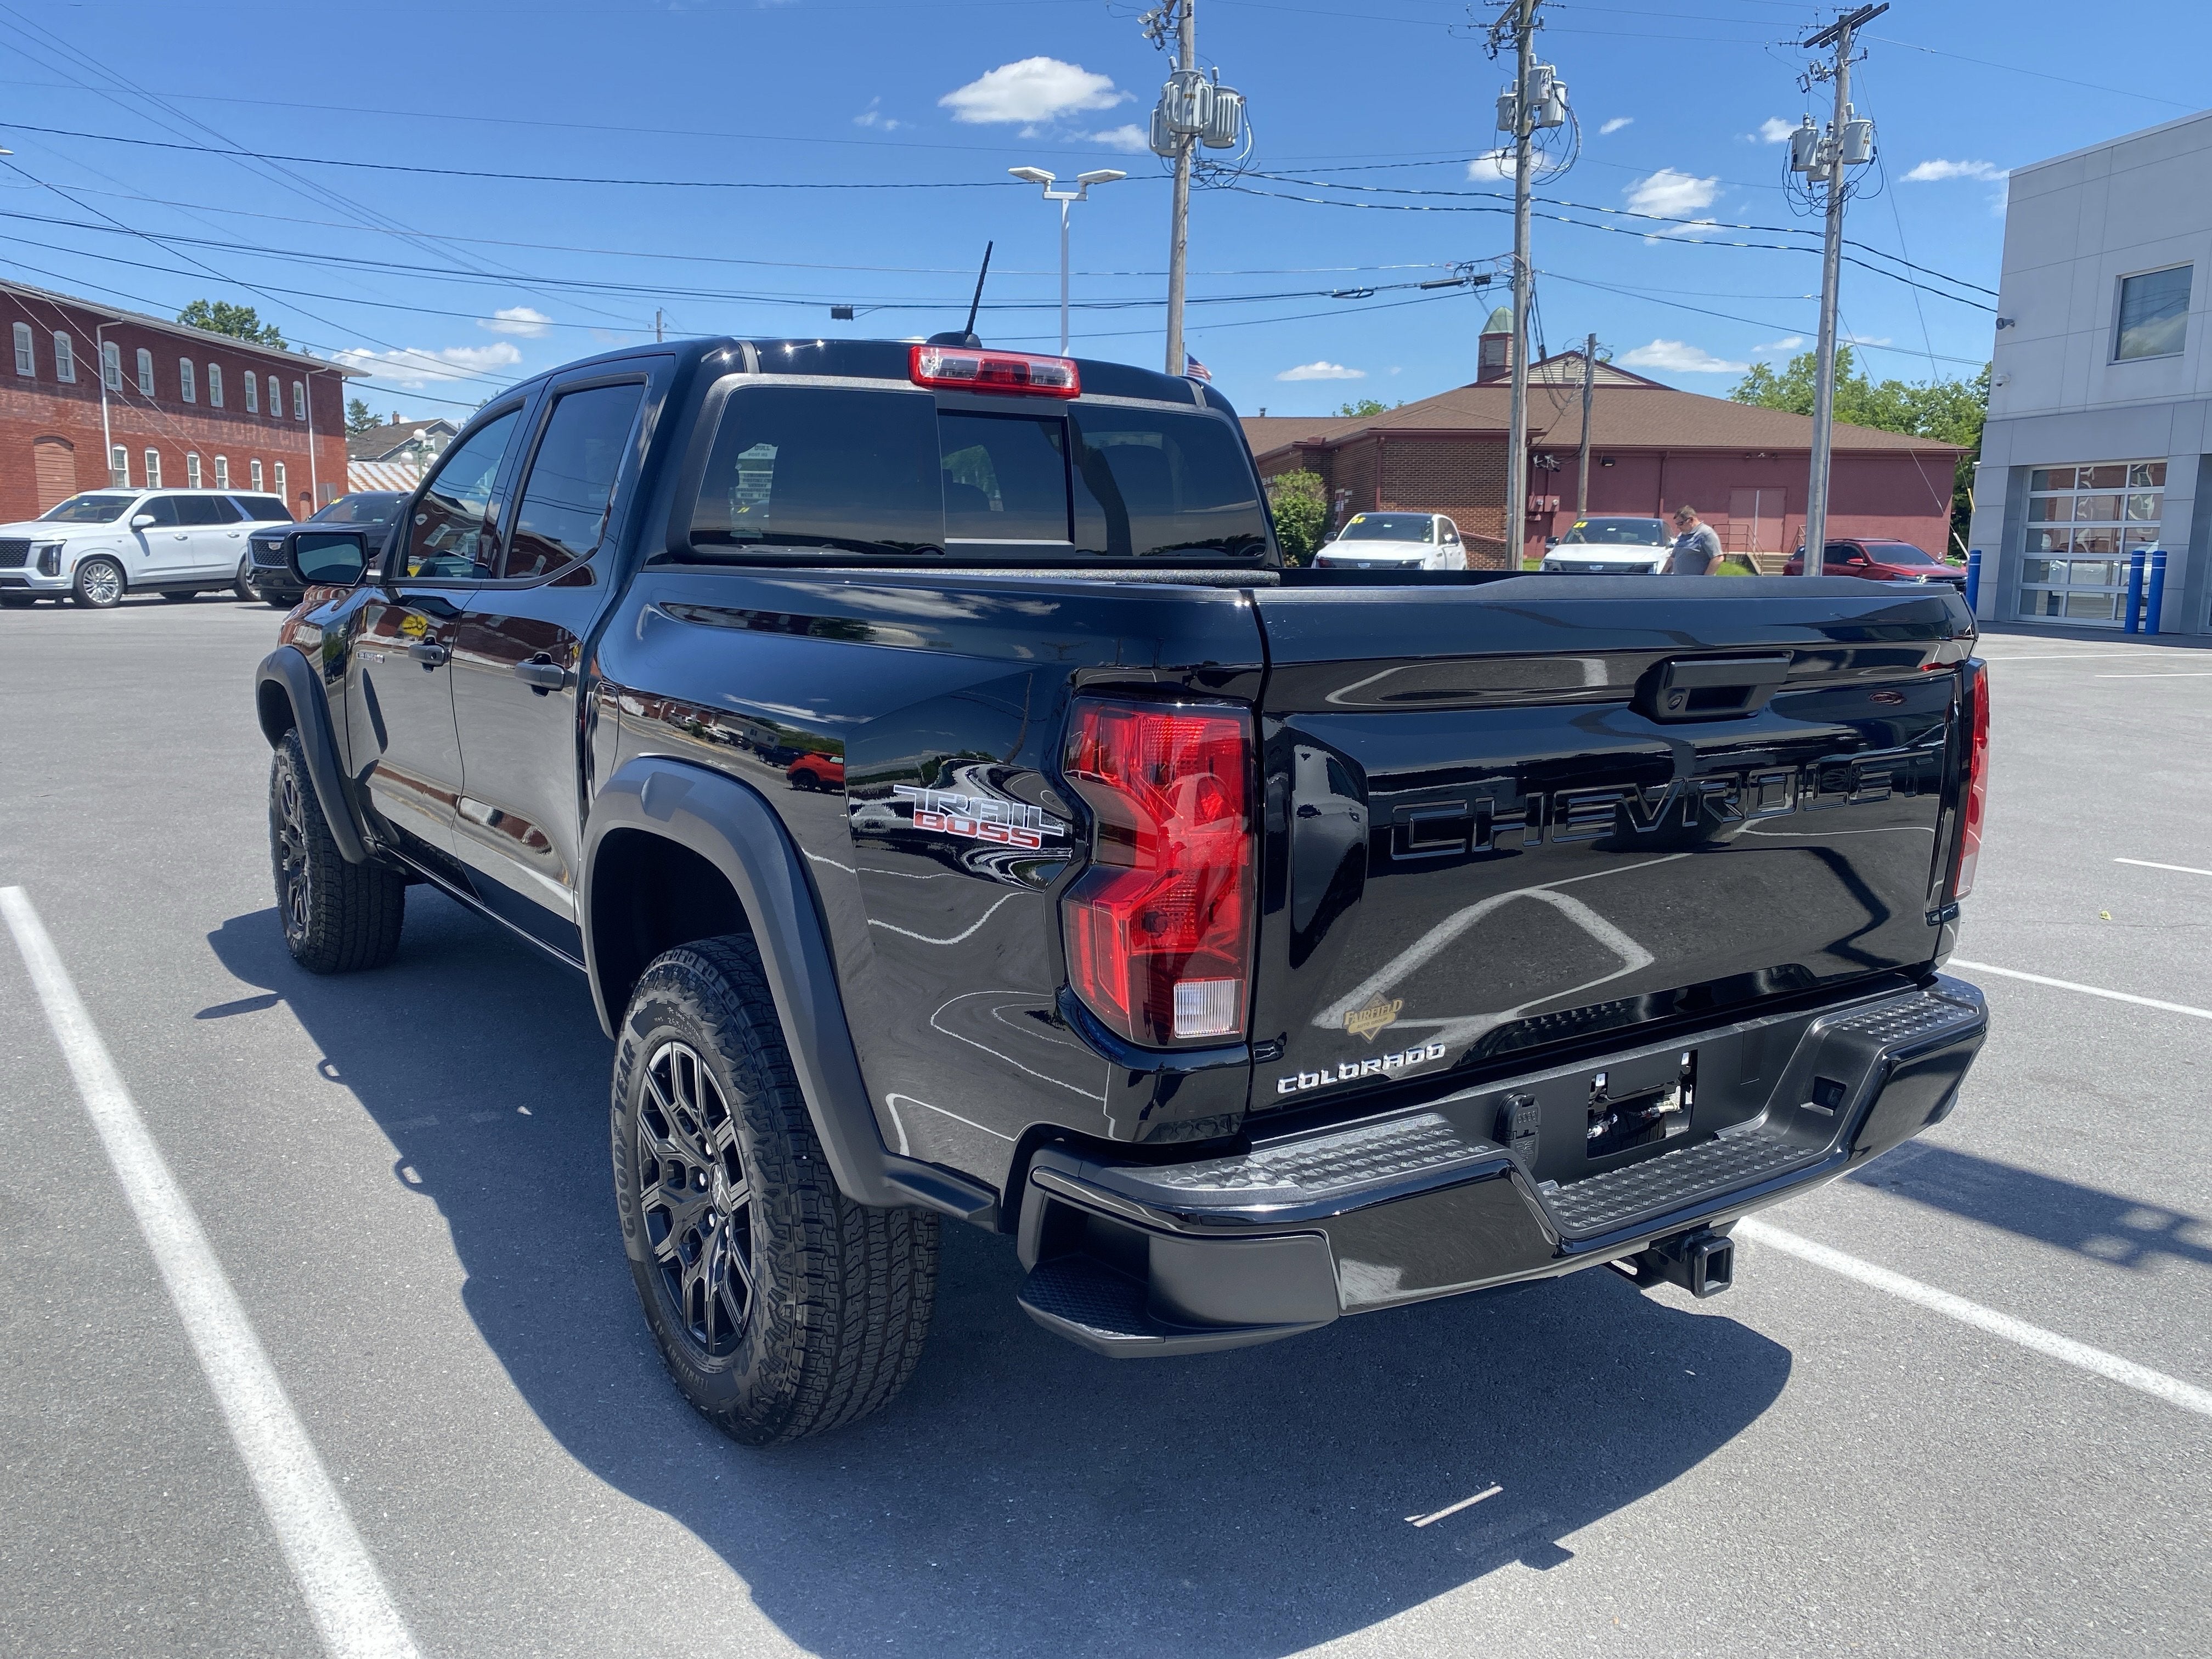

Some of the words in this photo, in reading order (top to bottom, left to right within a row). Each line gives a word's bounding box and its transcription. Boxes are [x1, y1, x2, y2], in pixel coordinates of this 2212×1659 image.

[893, 785, 1064, 837] TRAIL
[1392, 750, 1934, 861] CHEVROLET
[913, 810, 1041, 850] BOSS
[1344, 999, 1403, 1025] FAIRFIELD
[1357, 1021, 1370, 1029] AUTO
[1370, 1017, 1389, 1027] GROUP
[1277, 1042, 1446, 1094] COLORADO
[653, 1319, 664, 1335] AT
[666, 1343, 709, 1391] TERRITORY
